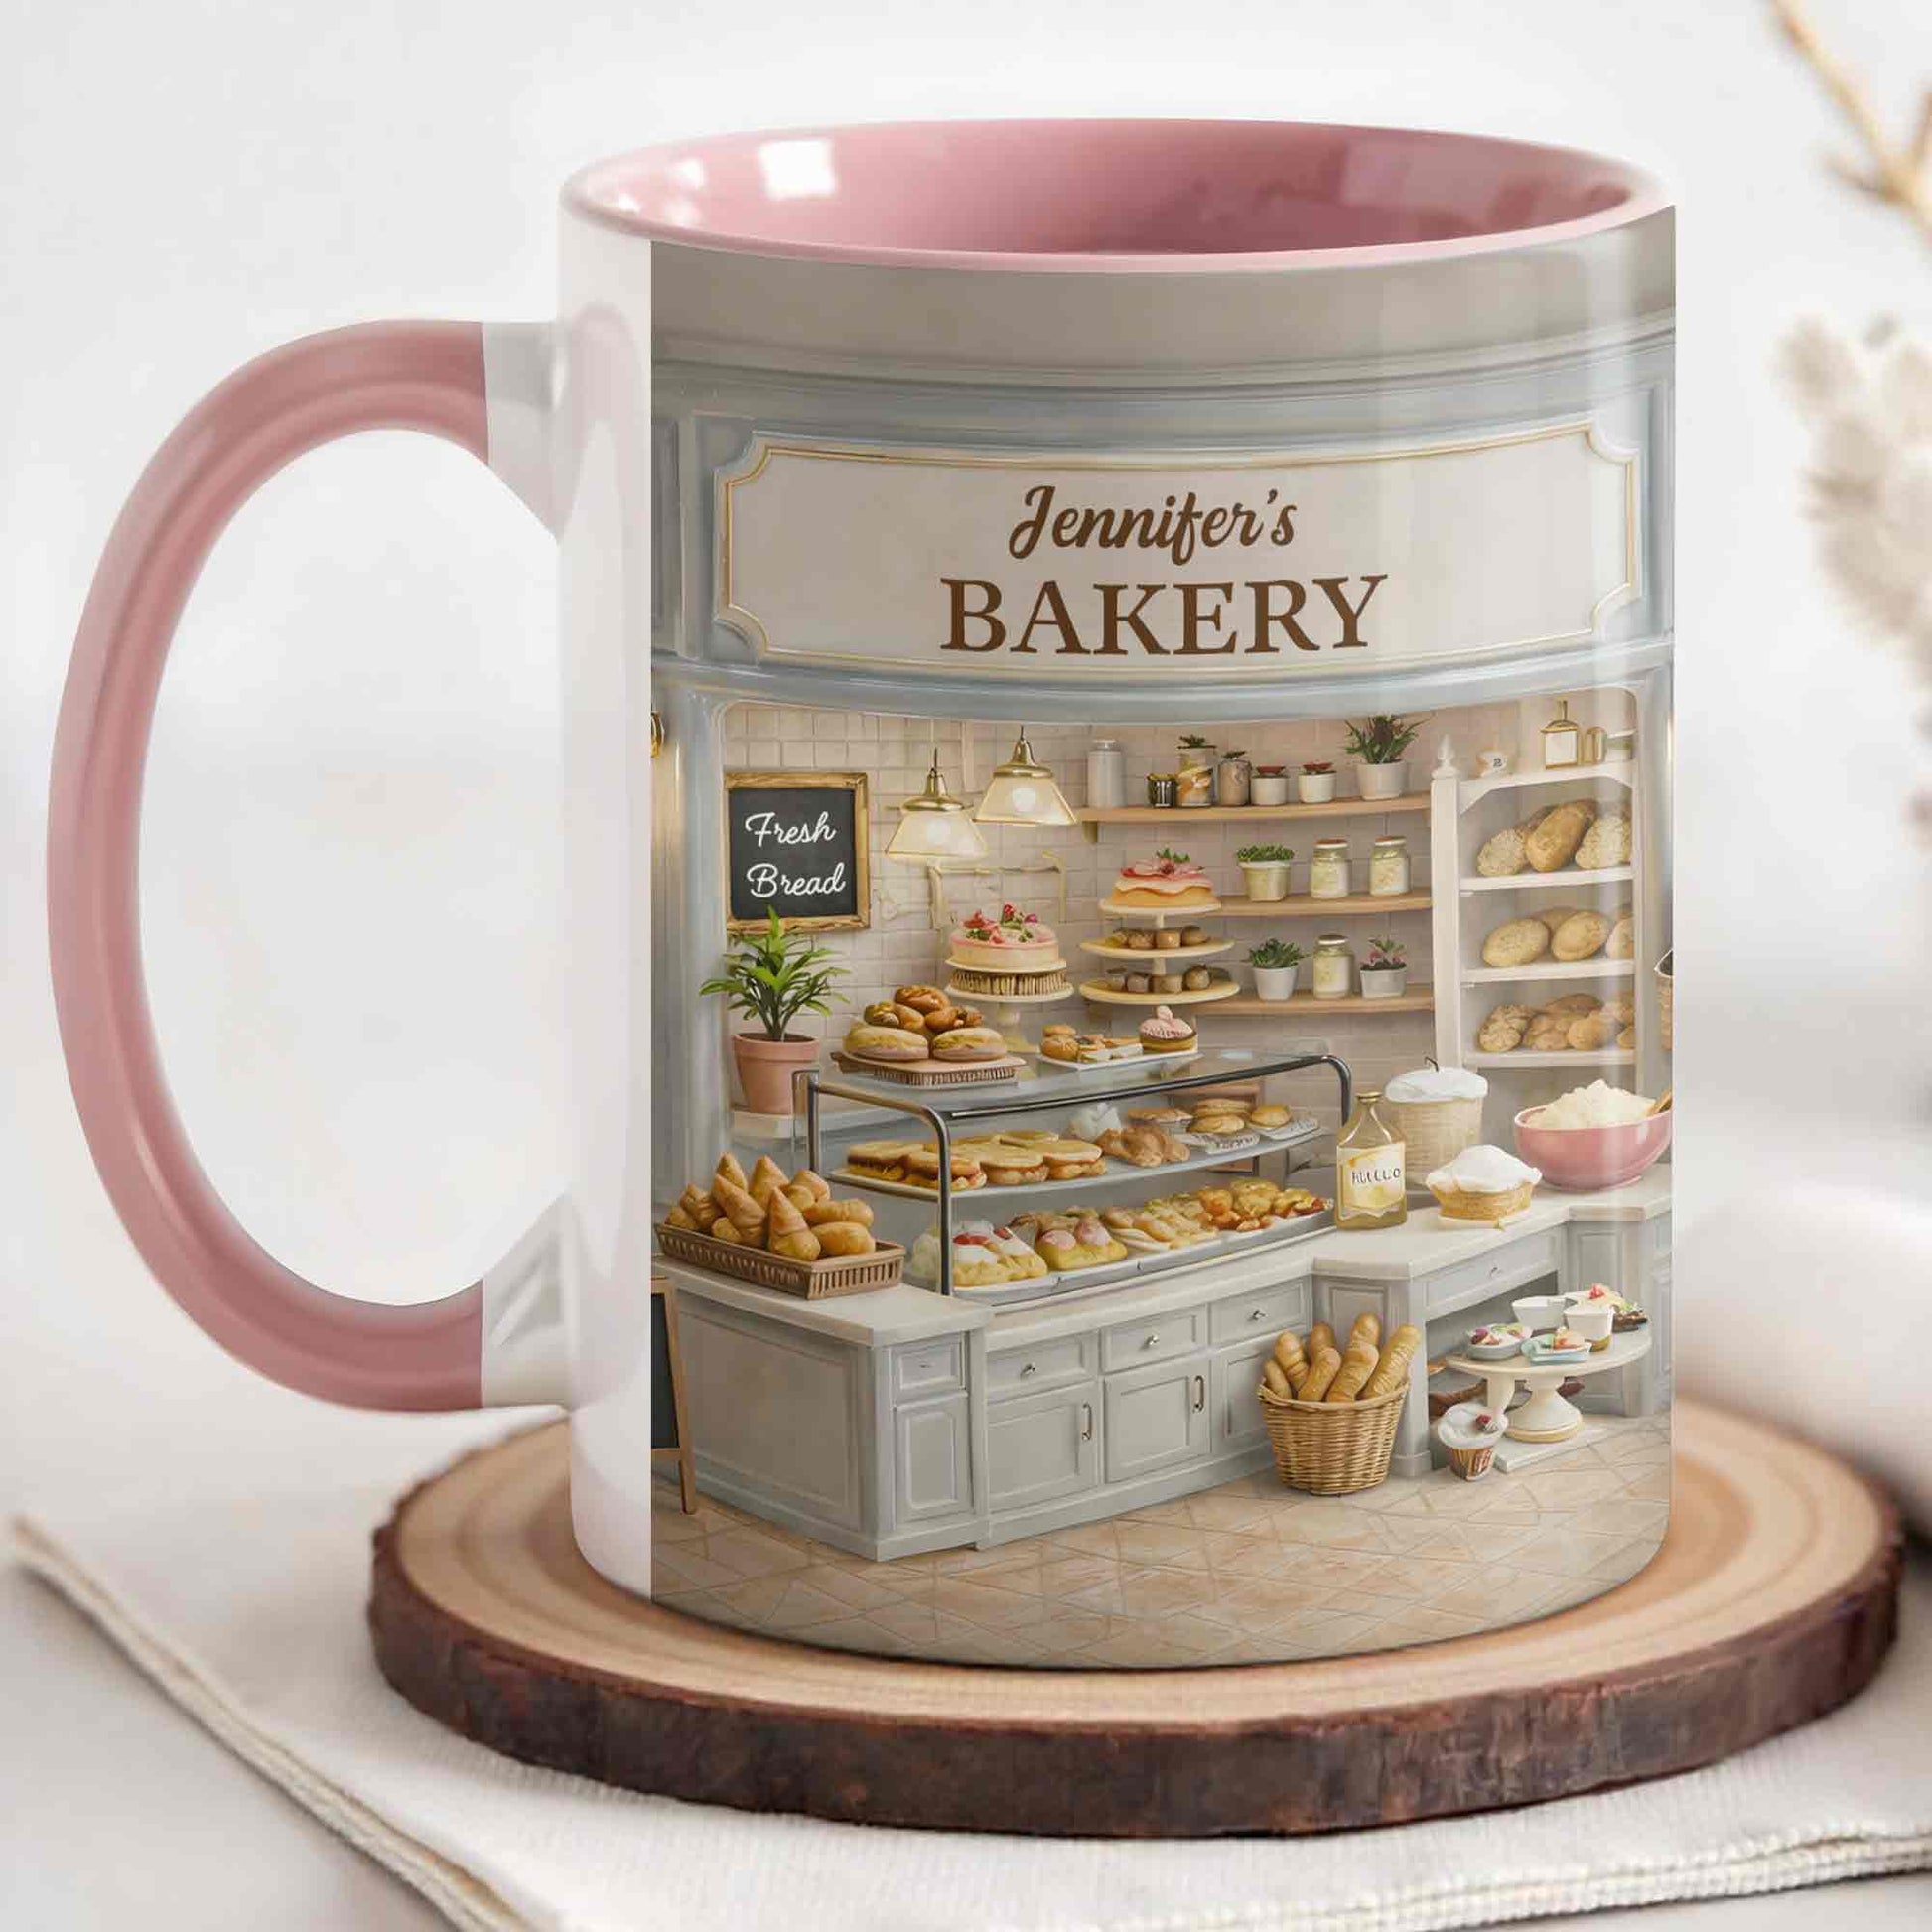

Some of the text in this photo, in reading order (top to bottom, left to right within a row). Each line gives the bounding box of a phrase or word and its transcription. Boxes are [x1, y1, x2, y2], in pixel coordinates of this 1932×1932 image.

[1008, 485, 1298, 566] Jennifer's
[939, 574, 1388, 656] BAKERY
[744, 811, 837, 848] Fresh
[746, 861, 847, 898] Bread
